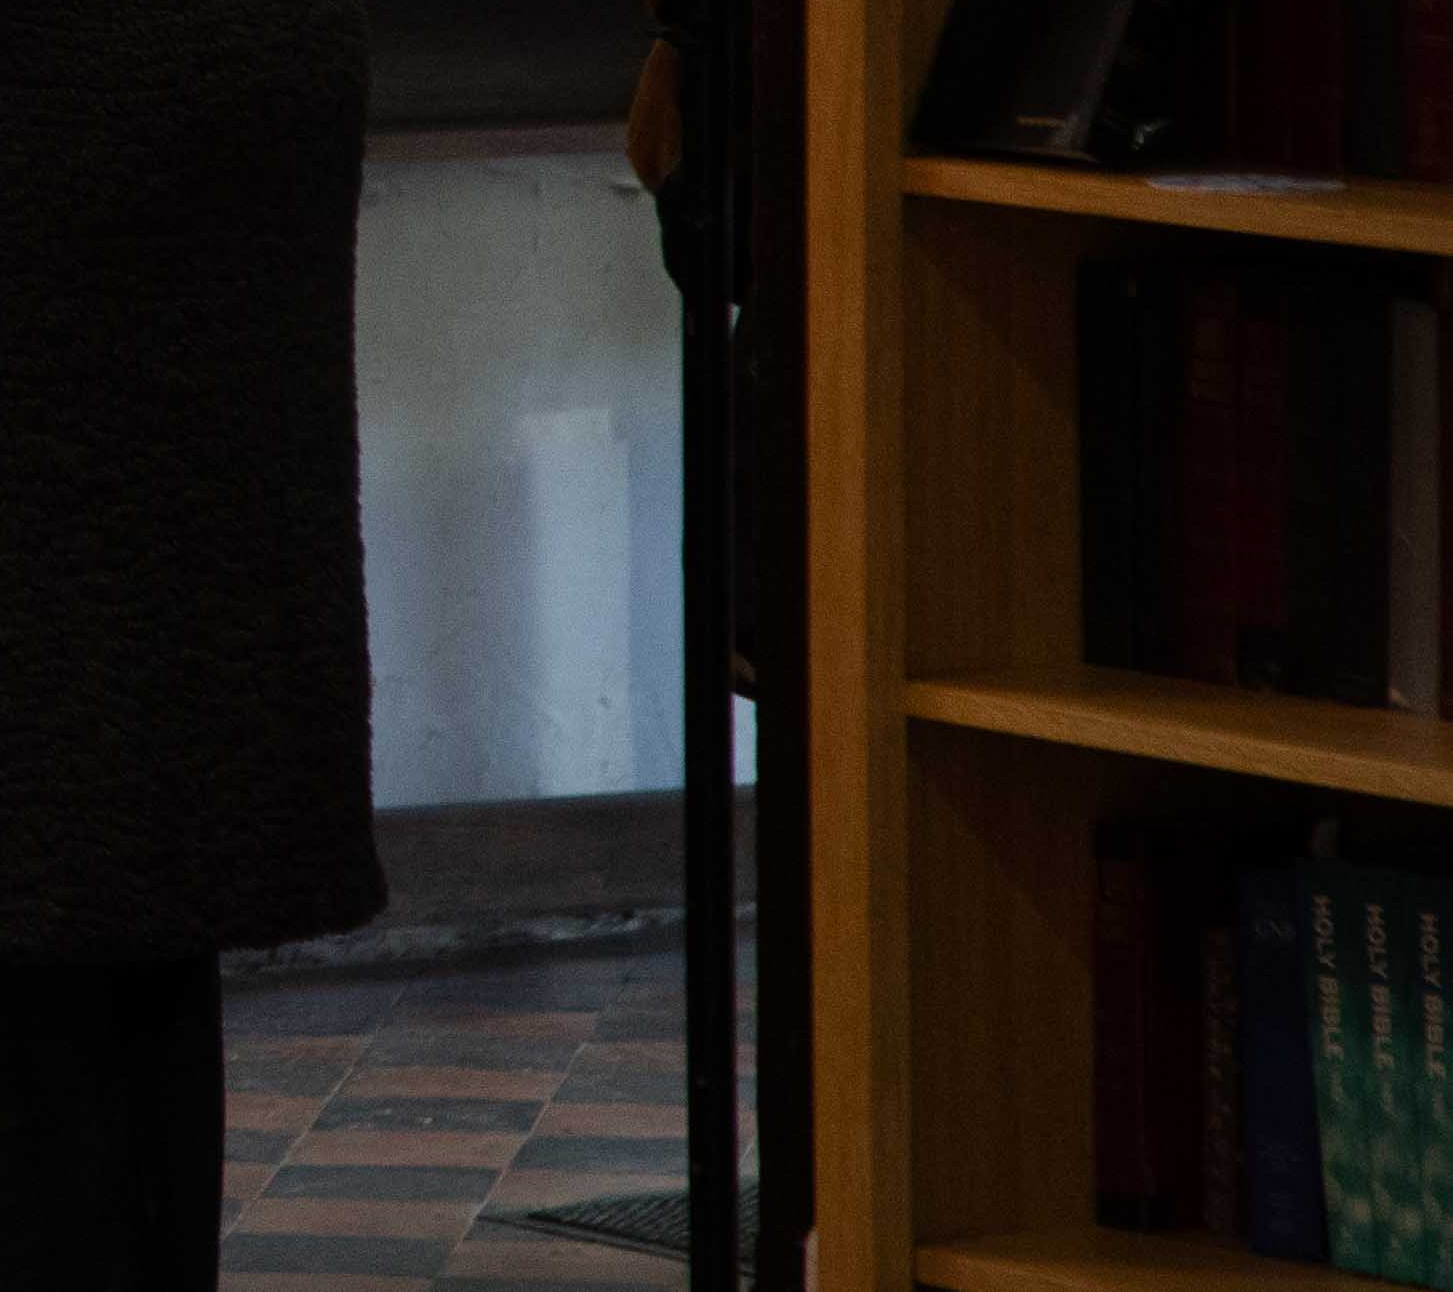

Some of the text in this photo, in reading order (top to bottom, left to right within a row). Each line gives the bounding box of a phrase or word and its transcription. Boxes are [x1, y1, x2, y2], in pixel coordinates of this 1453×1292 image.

[1310, 891, 1345, 1061] HOLY BIBLE
[1366, 903, 1395, 1071] HOLY BIBLE
[1417, 909, 1448, 1081] HOLY BIBLE
